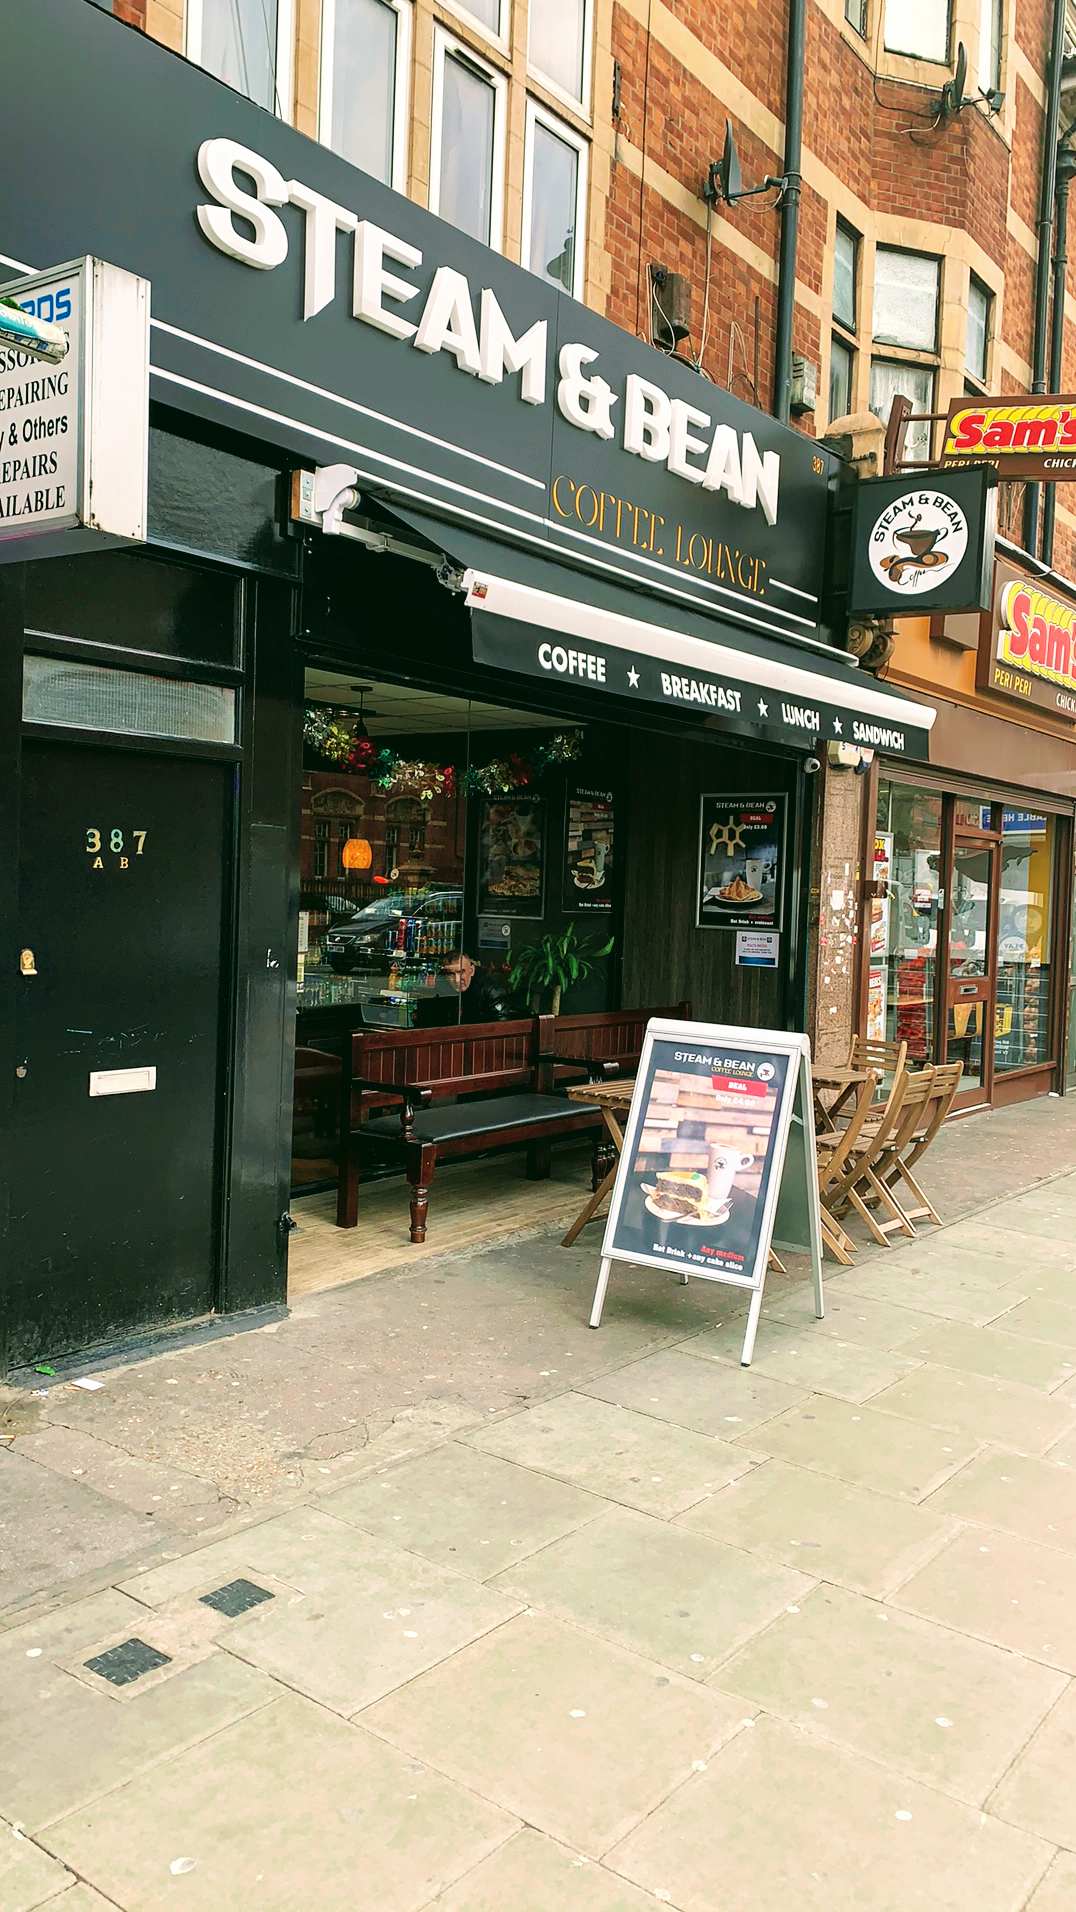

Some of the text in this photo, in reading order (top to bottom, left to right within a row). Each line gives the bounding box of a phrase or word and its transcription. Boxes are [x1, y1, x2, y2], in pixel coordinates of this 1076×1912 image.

[197, 137, 781, 527] STEAM & BEAN
[8, 422, 18, 446] &
[23, 415, 68, 442] Others
[0, 451, 58, 485] EPAIRS
[811, 455, 825, 475] 387
[873, 493, 964, 543] STEAM & BEAN
[551, 474, 766, 596] COFFEE LOUNGE
[994, 667, 1032, 696] PERI PERI
[538, 642, 905, 751] COFFEE BREAKFAST LUNCH SANDWICH
[86, 828, 148, 855] 387
[93, 856, 129, 869] A B
[674, 1051, 756, 1072] STEAM & BEAN
[715, 1094, 732, 1105] Only
[727, 1081, 748, 1091] DEAL
[652, 1243, 666, 1253] Hot
[666, 1247, 686, 1258] Drink
[706, 1257, 724, 1267] cake
[725, 1261, 744, 1271] slice
[700, 1245, 745, 1262] Any medium
